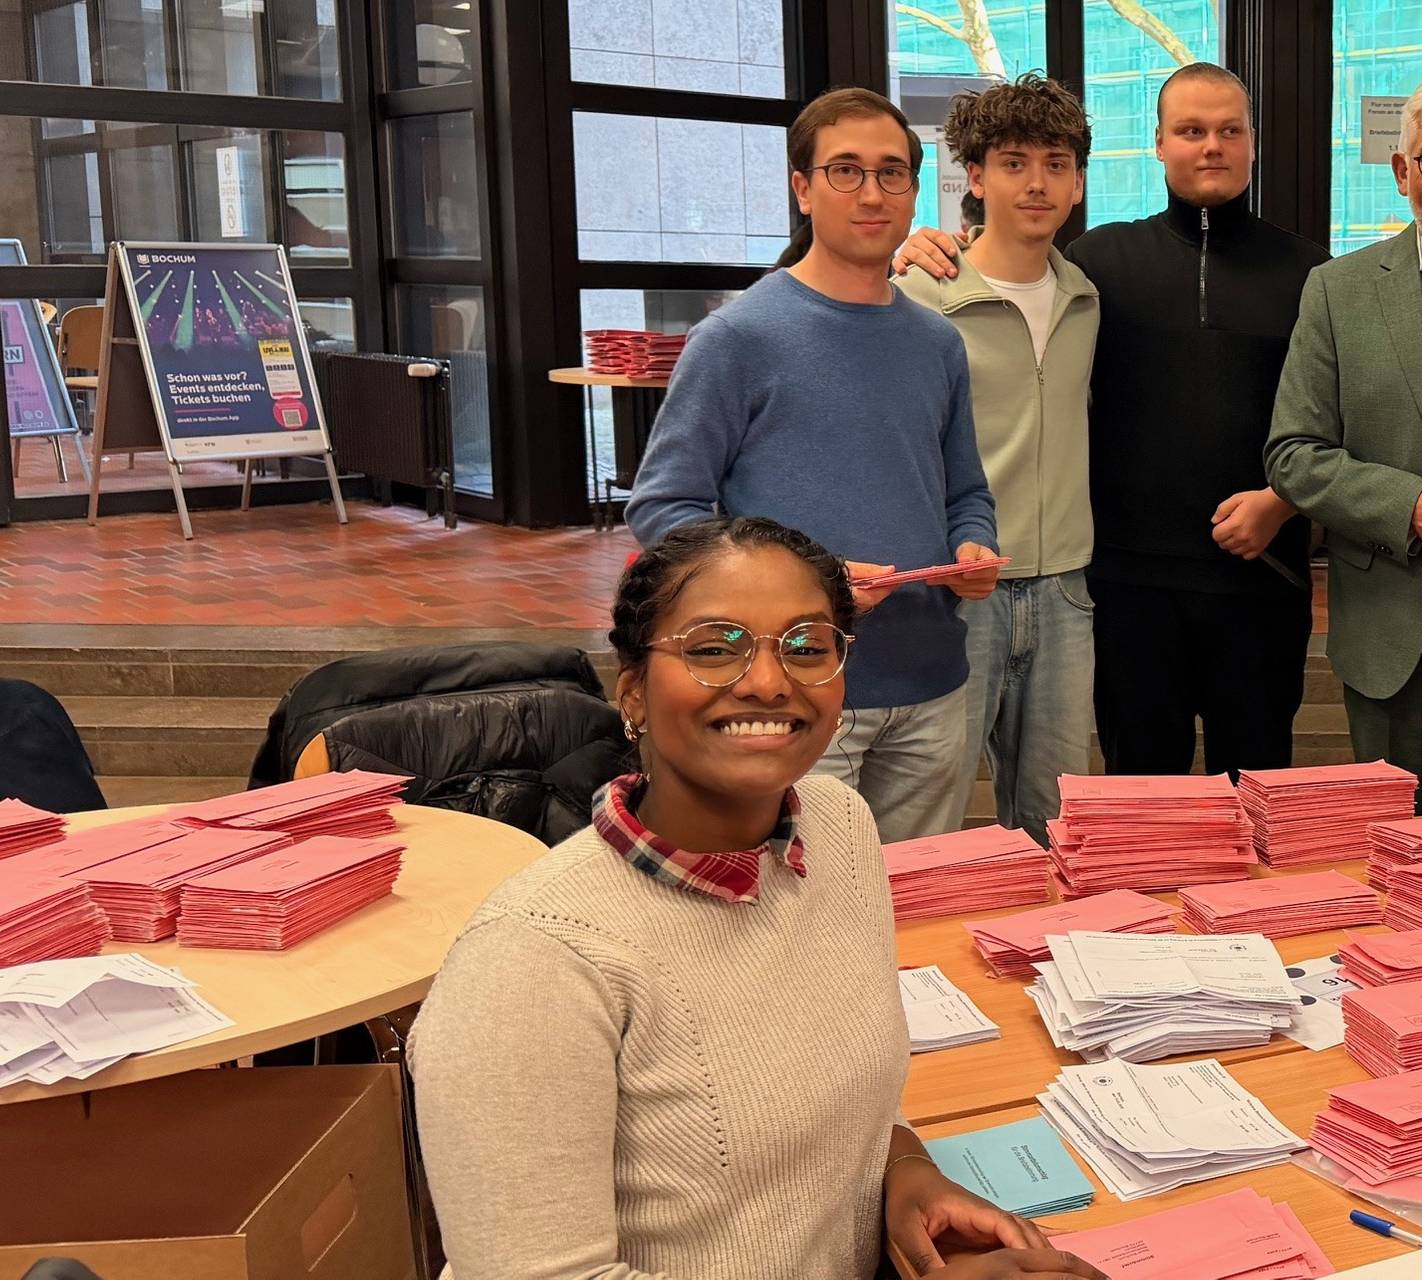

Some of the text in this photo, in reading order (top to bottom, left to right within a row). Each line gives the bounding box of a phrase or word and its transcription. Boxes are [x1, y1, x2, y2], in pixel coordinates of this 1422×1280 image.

[151, 254, 196, 264] BOCHUM
[166, 371, 247, 383] Schon was vor?
[169, 382, 265, 394] Events entdecken,
[171, 393, 251, 405] Tickets buchen
